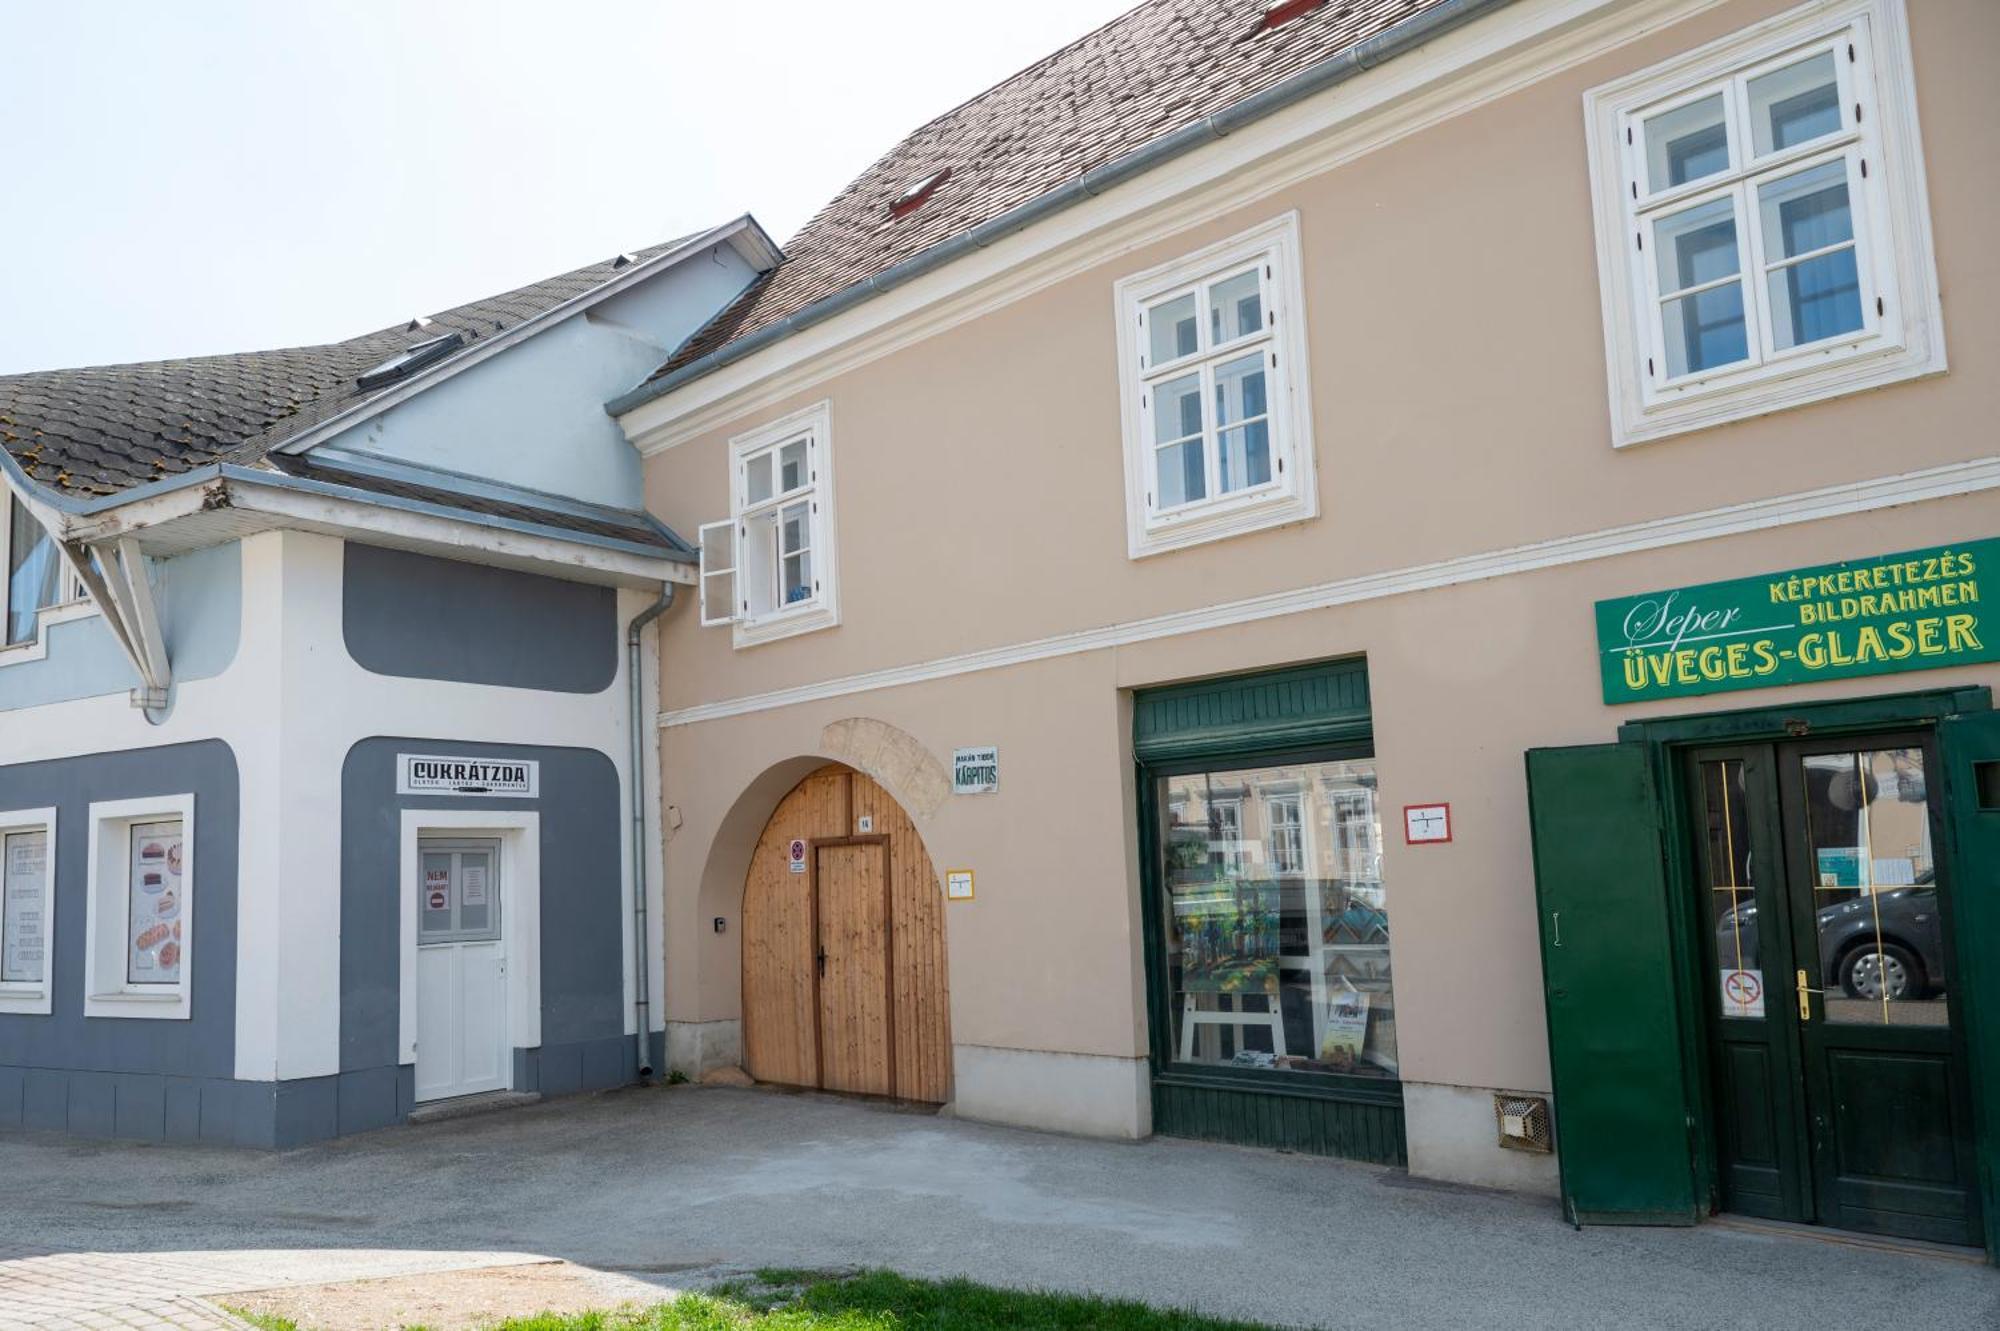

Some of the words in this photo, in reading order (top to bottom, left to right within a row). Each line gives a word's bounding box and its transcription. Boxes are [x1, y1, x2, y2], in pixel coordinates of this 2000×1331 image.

[1769, 551, 1976, 604] KÉPKERETEZÉS
[1623, 591, 1742, 652] Seper
[1800, 580, 1980, 625] BILDRAHMEN
[1623, 613, 1984, 690] ÜVEGES-GLASER
[414, 761, 526, 783] CUKRÁTZDA
[955, 765, 997, 786] KÁRPITOS
[427, 871, 448, 881] NEM
